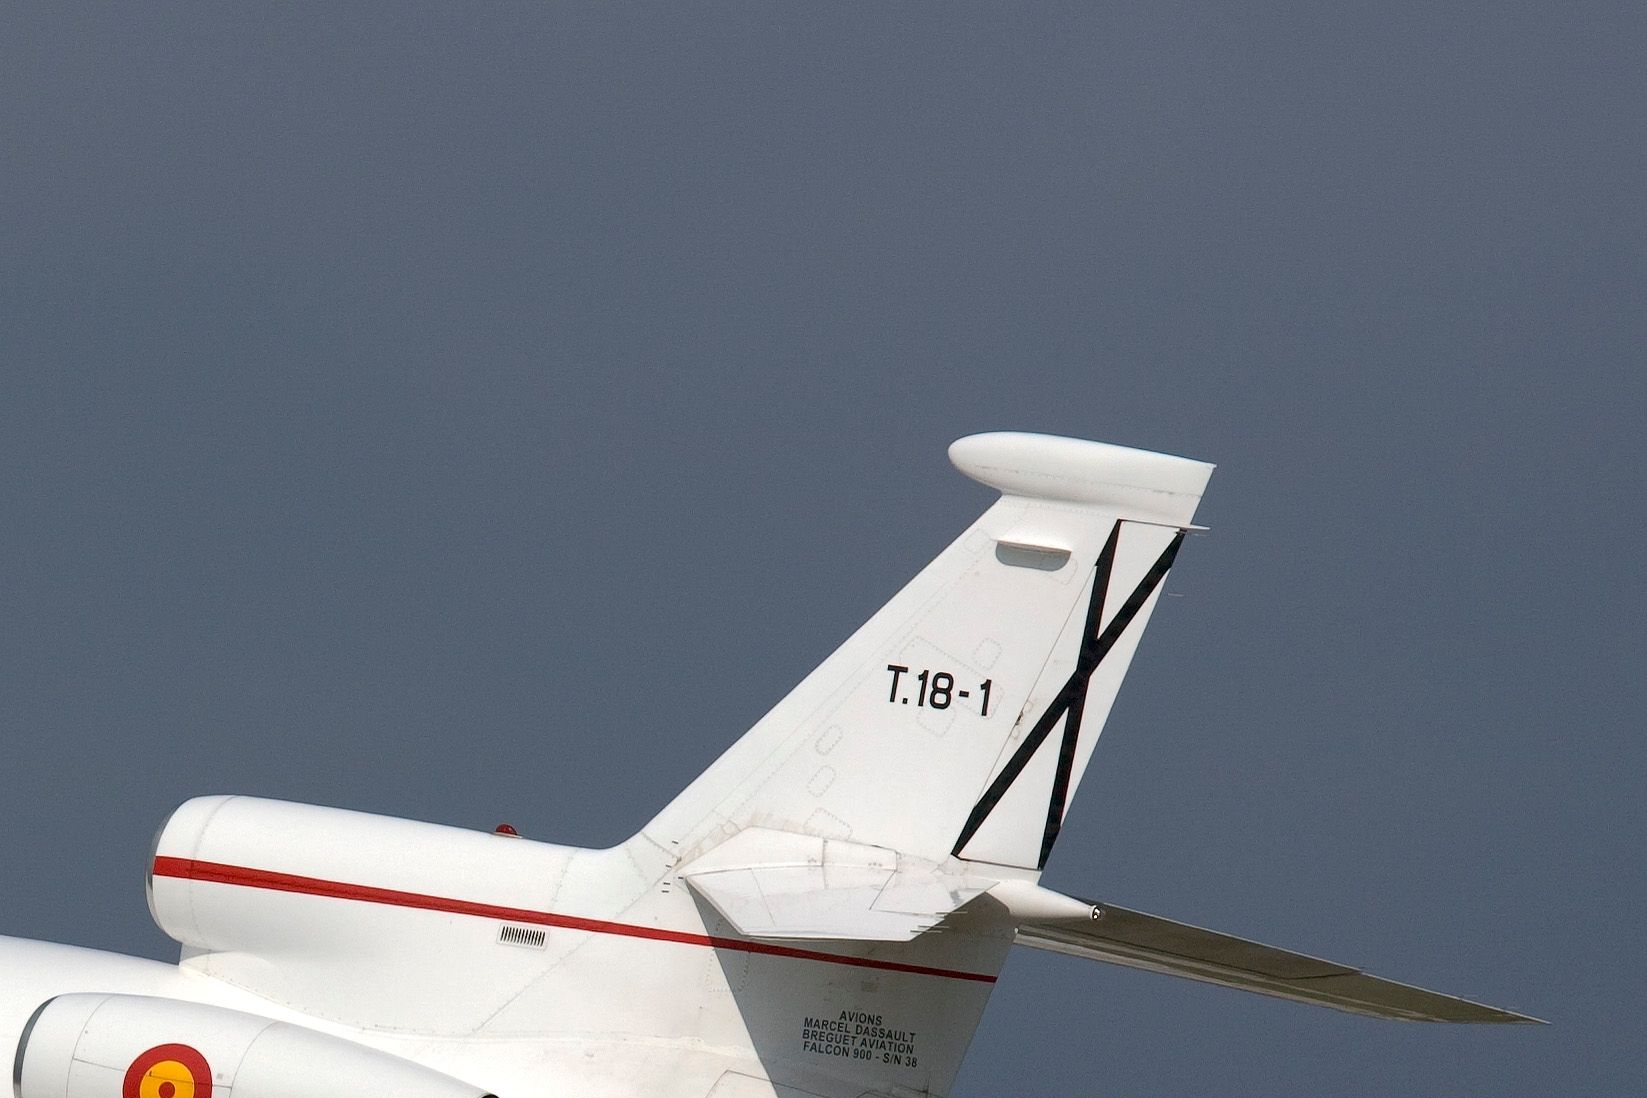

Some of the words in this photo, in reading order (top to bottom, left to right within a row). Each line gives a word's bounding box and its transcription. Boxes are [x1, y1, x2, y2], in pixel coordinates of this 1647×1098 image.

[887, 664, 992, 717] T.18-1
[803, 1017, 851, 1034] MARCEL
[855, 1024, 916, 1043] DASSAULT
[839, 1010, 883, 1026] AVIONS
[802, 1029, 858, 1046] BREGUET
[860, 1037, 914, 1054] AVIATION
[803, 1040, 850, 1058] FALCON
[853, 1048, 872, 1060] 900
[882, 1052, 902, 1065] S/N
[905, 1056, 918, 1068] 38
